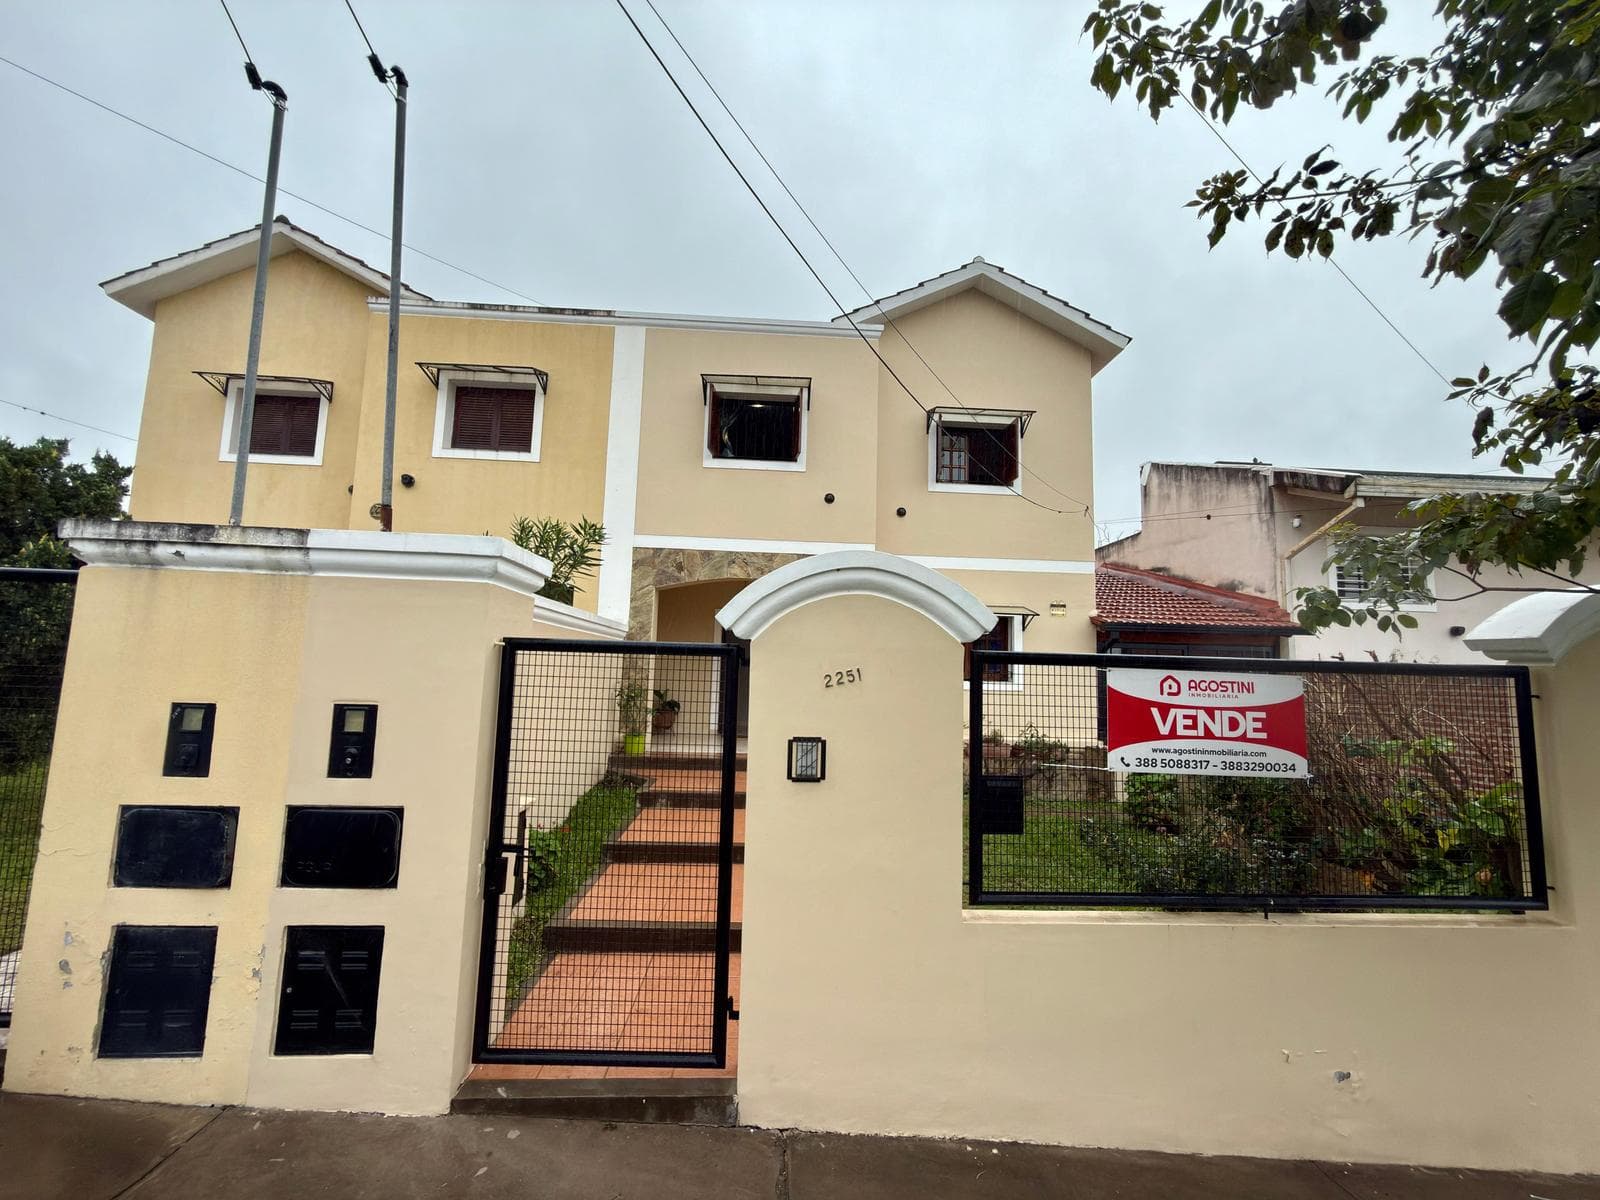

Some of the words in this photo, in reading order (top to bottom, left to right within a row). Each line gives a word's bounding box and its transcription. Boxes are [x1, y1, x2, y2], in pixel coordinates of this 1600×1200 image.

[824, 667, 862, 688] 2251
[1188, 679, 1255, 694] AGOSTINI
[1150, 707, 1268, 739] VENDE
[1151, 747, 1267, 758] www.agostininmobiliaria.com
[1135, 757, 1157, 768] 388
[1160, 758, 1210, 770] 5088317
[1220, 760, 1297, 773] 3883290034
